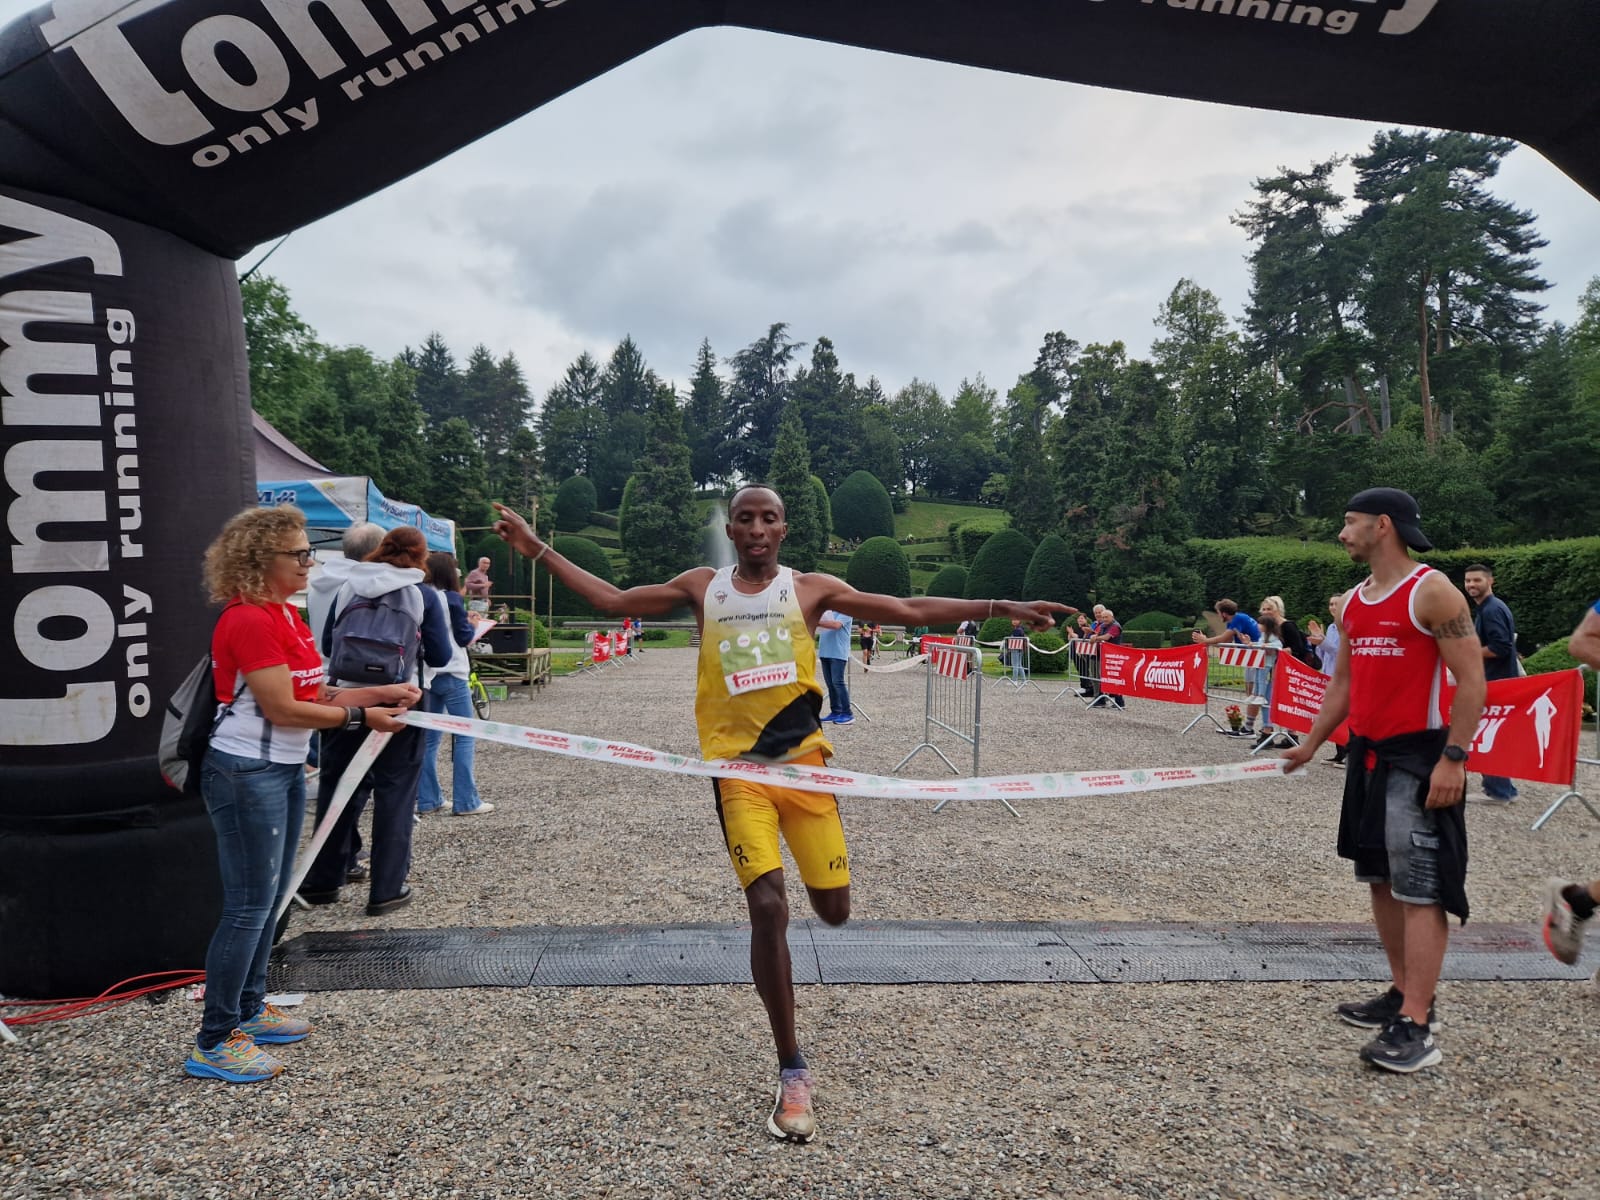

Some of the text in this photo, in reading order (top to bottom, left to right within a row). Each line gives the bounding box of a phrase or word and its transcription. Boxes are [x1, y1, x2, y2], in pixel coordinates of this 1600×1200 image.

[1139, 0, 1360, 35] unning
[192, 0, 568, 168] only runnin
[104, 306, 153, 719] only running
[751, 645, 763, 666] 1
[1349, 636, 1399, 648] UNNER
[1351, 647, 1406, 657] VARESE
